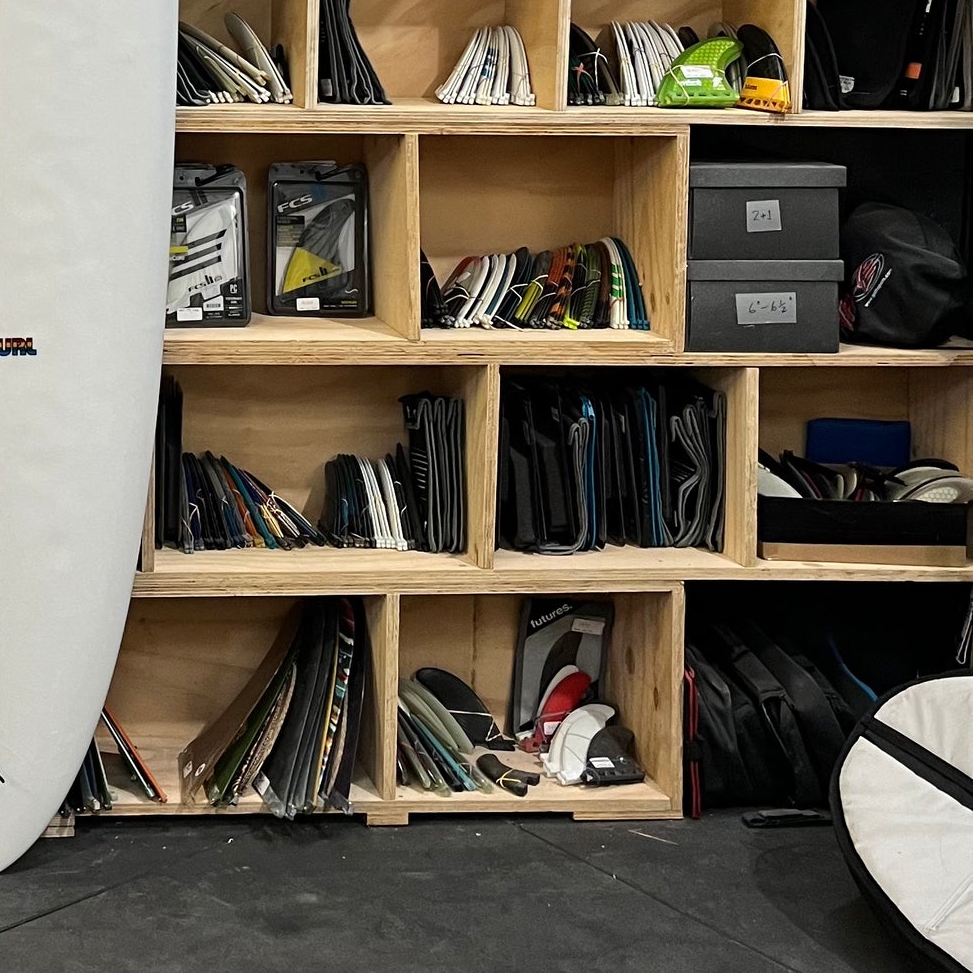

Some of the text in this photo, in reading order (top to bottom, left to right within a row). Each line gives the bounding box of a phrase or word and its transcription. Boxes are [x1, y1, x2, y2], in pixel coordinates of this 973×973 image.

[172, 201, 194, 215] CS
[277, 194, 313, 213] FCS
[752, 210, 771, 221] 2+1
[530, 603, 573, 629] futures.
